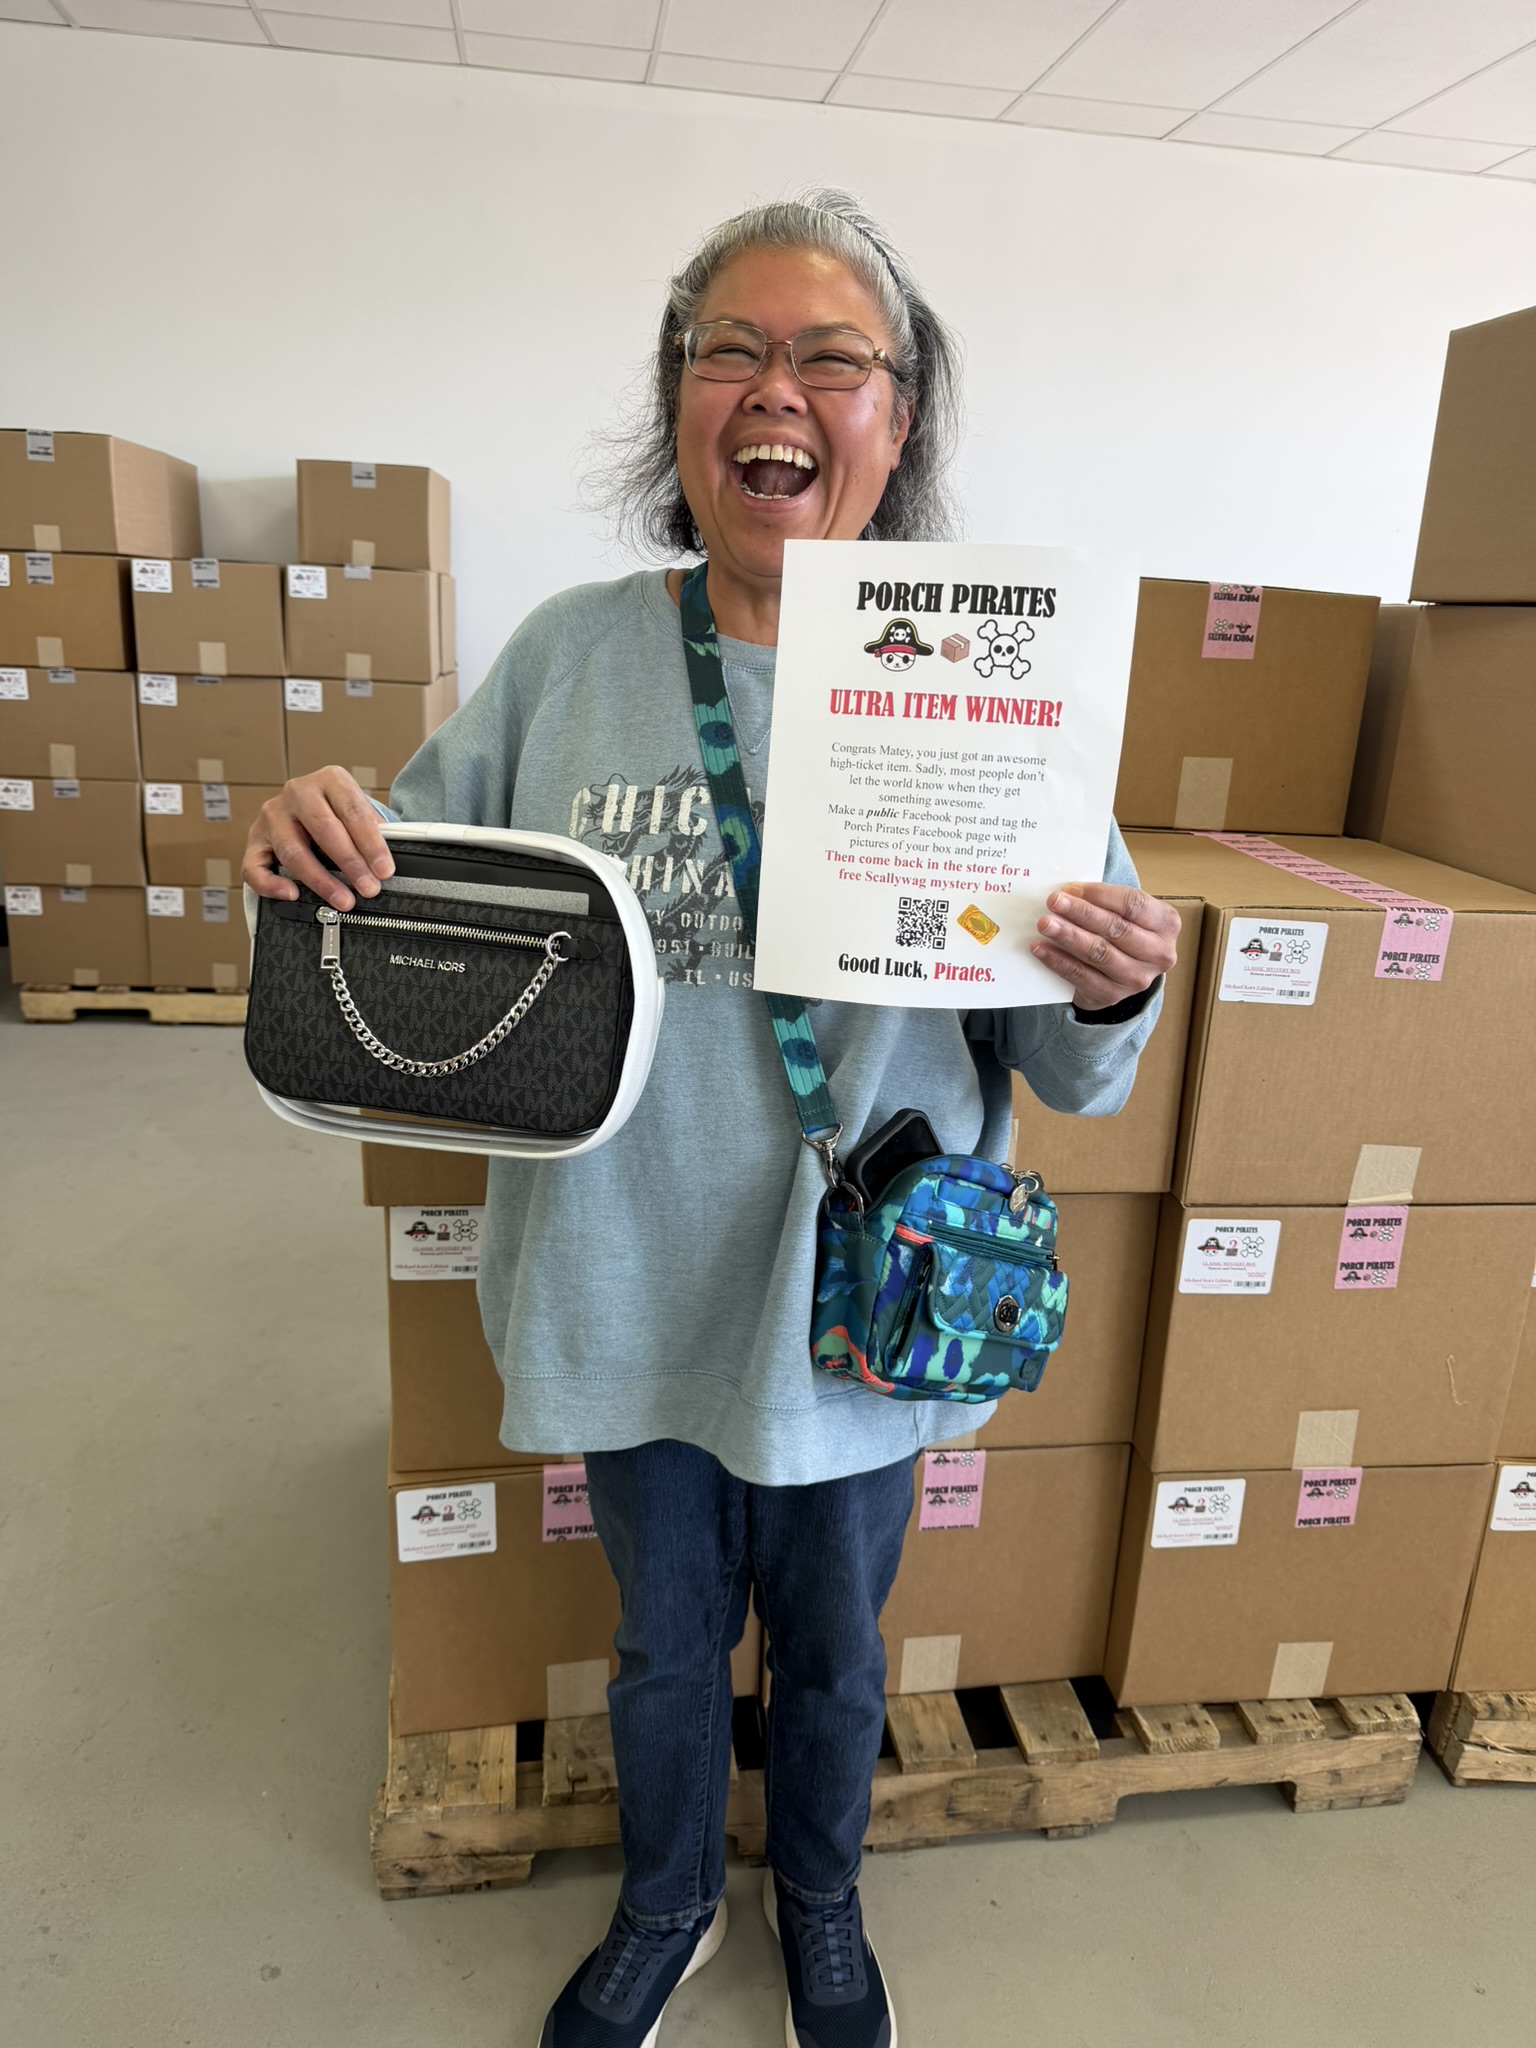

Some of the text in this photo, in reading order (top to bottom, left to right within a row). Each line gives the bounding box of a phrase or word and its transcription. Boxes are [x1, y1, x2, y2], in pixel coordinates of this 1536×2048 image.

[856, 580, 1057, 618] PORCH PIRATES
[829, 688, 1063, 728] ULTRA ITEM WINNER!
[832, 742, 1047, 766] Congrats Matey, you just got an awesome
[830, 758, 883, 771] high-ticket
[886, 761, 912, 772] item.
[915, 763, 946, 777] Sadly,
[950, 767, 976, 777] most
[978, 769, 1014, 781] people
[850, 774, 1021, 798] let the world know when they get
[568, 783, 711, 839] CHIC
[878, 794, 986, 809] something awesome.
[828, 804, 1037, 830] Make a public Facebook post and tag the
[844, 820, 1017, 843] Porch Pirates Facebook page with
[850, 837, 1007, 859] pictures of your box and prize!
[825, 850, 1030, 877] Then come back in the store for a
[838, 868, 1012, 894] free Scallywag mystery box!
[681, 910, 742, 931] OUTDO
[1259, 926, 1304, 936] PORCH PIRATES
[656, 938, 754, 960] 951 BUIL
[1382, 951, 1440, 964] PORCH PIRATES
[389, 954, 466, 973] MICHAEL KORS
[838, 953, 996, 982] Good Luck, Pirates.
[728, 971, 753, 988] US
[1346, 1218, 1402, 1227] PORCH PIRATES
[1339, 1261, 1395, 1270] PORCH PIRATES
[548, 1485, 574, 1494] PORCH
[546, 1526, 573, 1536] PORCH
